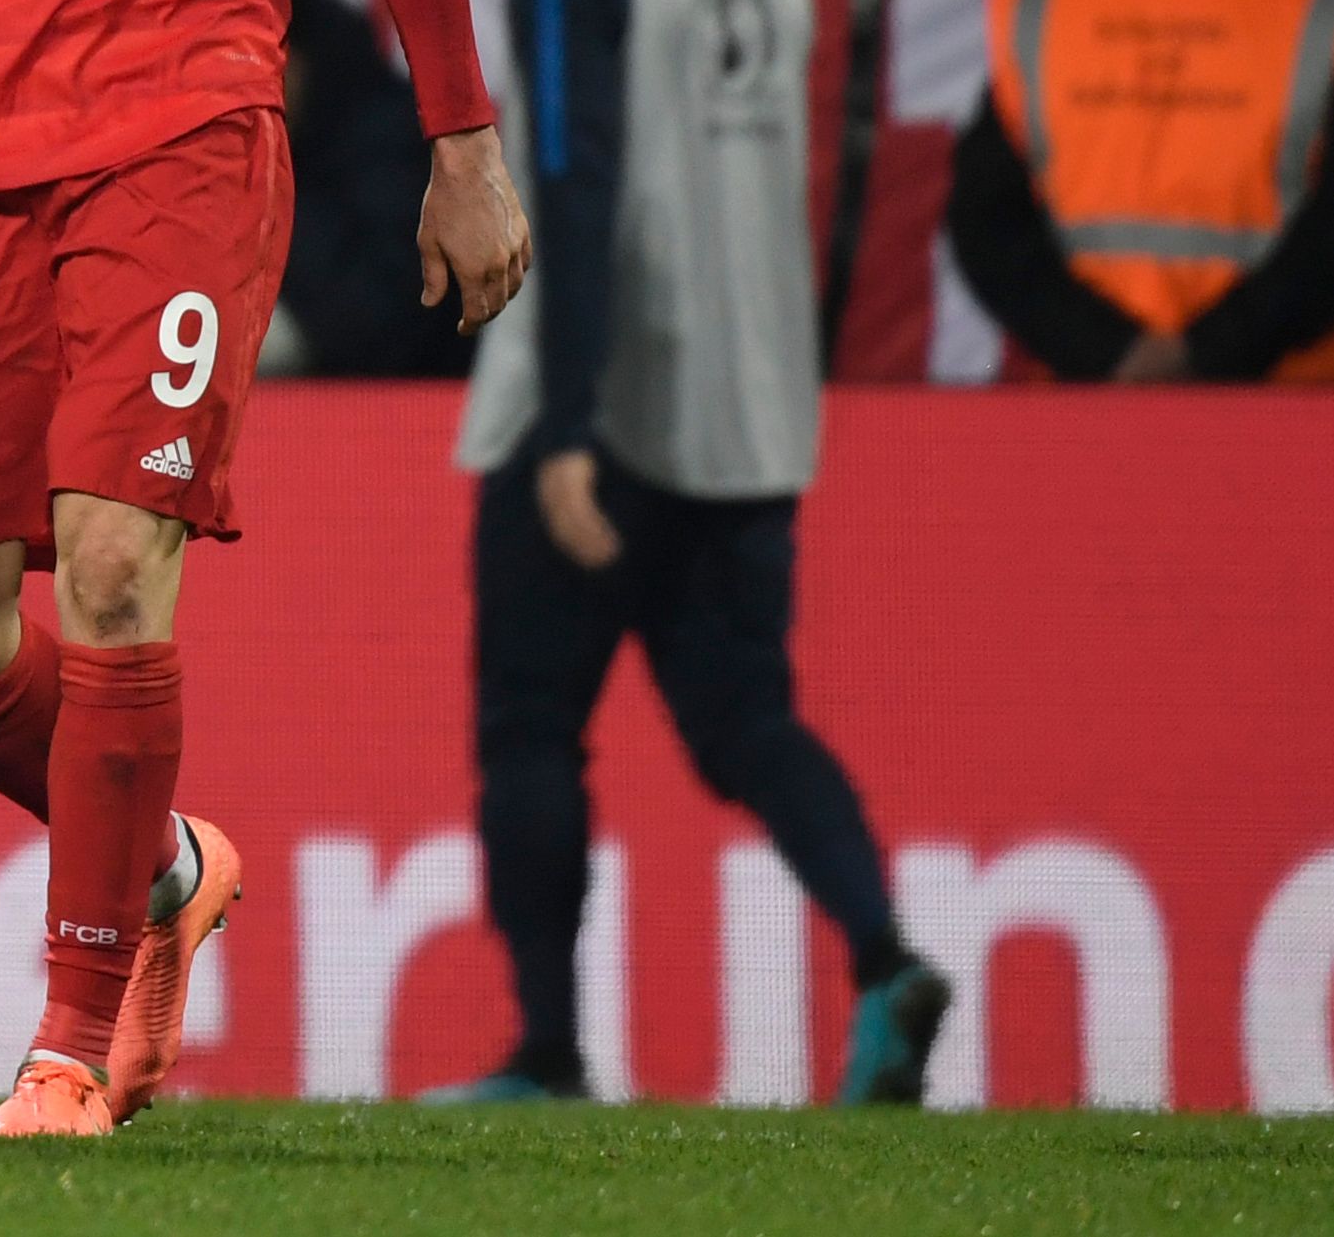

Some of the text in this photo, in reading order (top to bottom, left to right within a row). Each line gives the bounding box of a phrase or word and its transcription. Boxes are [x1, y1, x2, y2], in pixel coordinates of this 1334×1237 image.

[150, 290, 220, 409] 9
[139, 455, 195, 482] adidas
[59, 919, 119, 945] FCB
